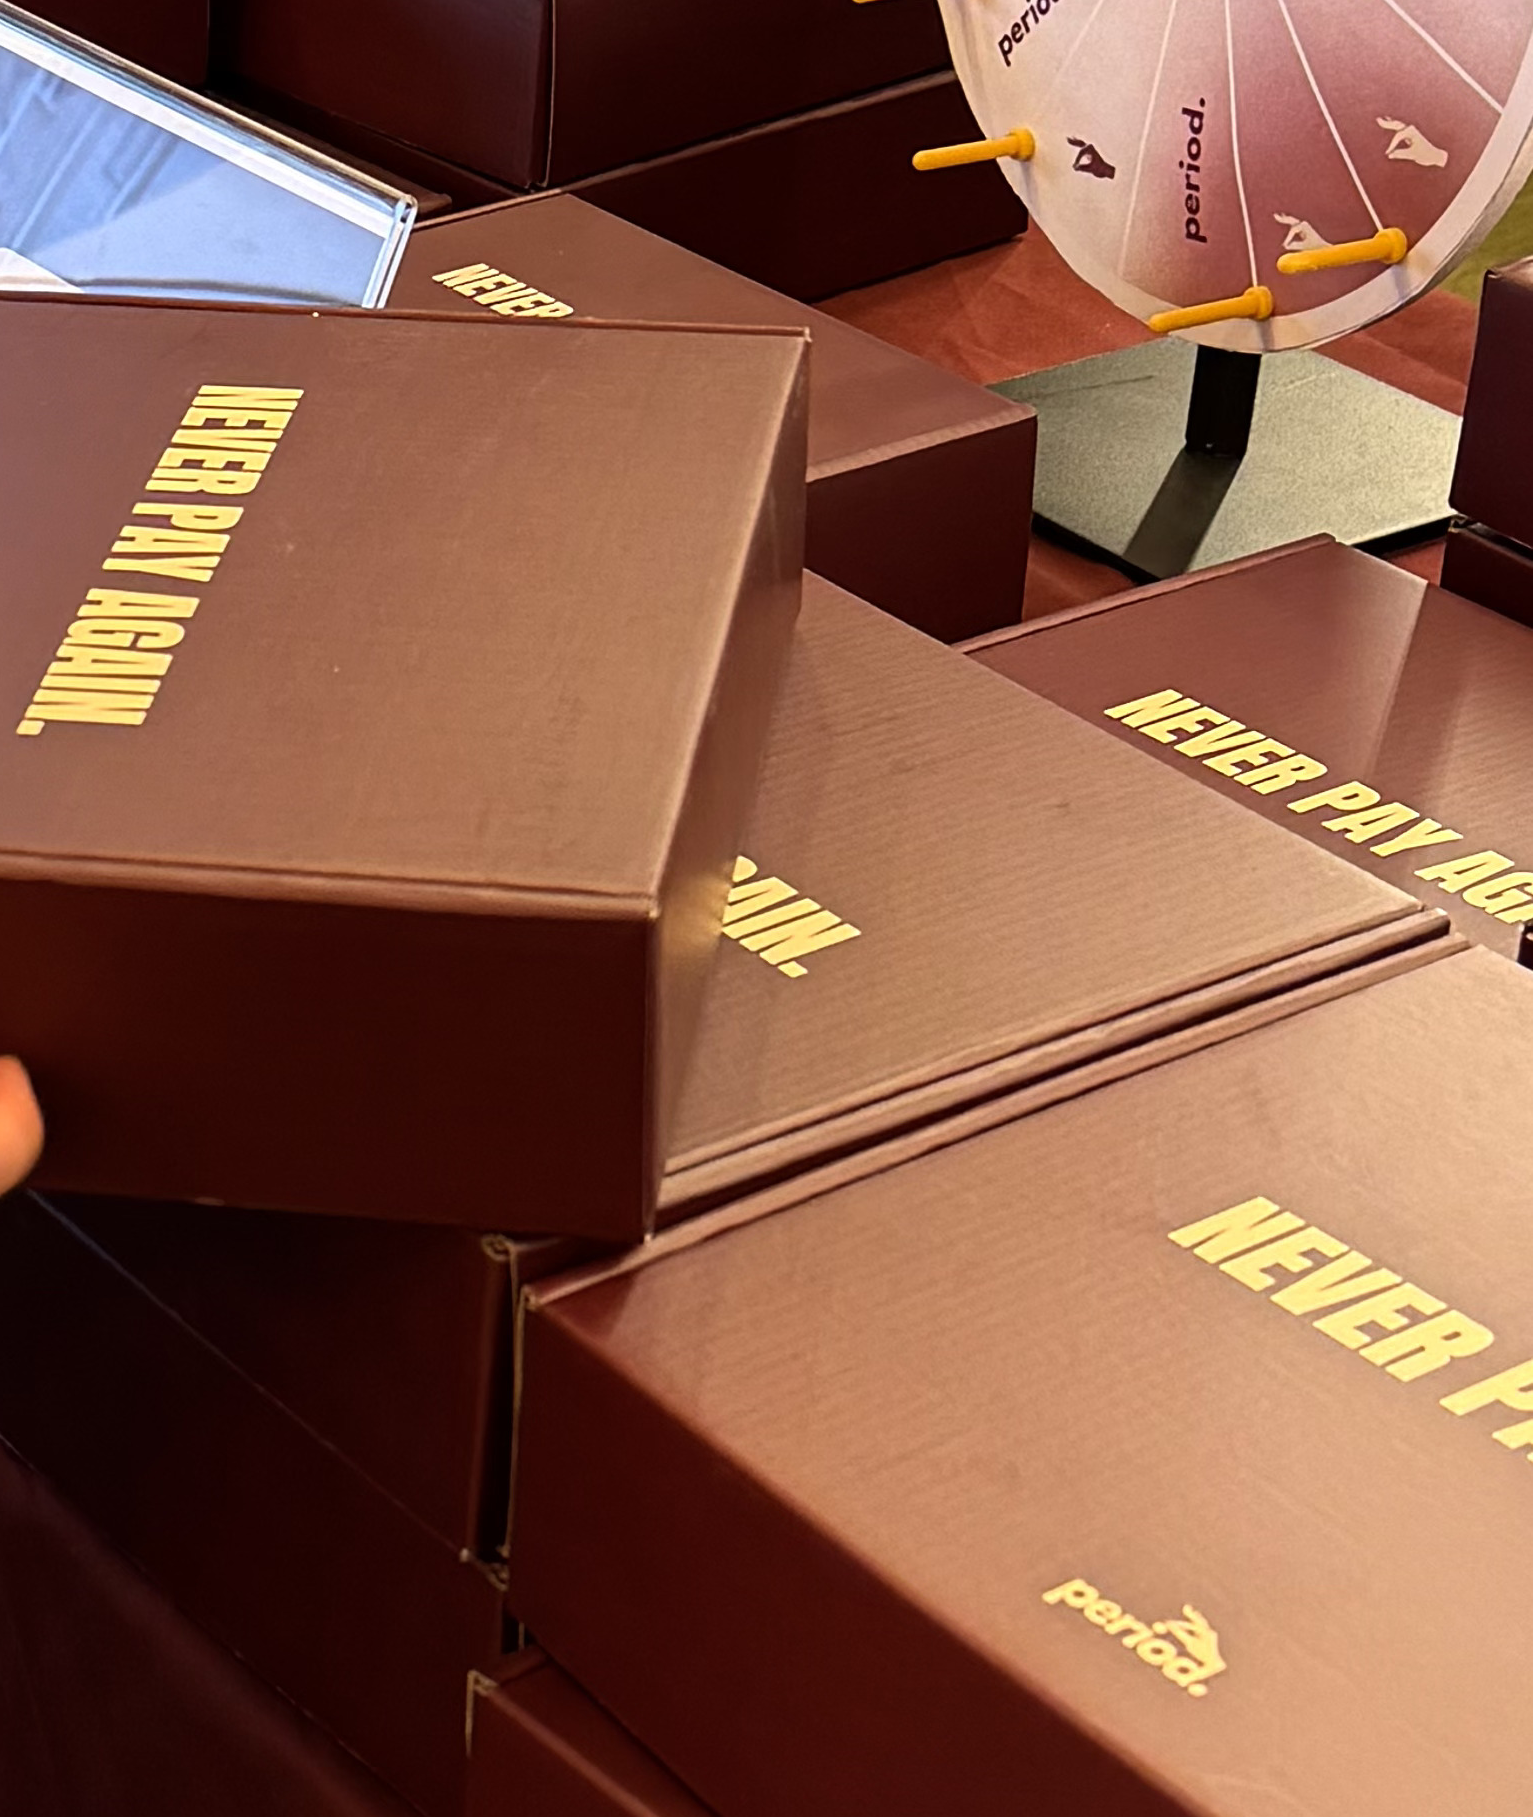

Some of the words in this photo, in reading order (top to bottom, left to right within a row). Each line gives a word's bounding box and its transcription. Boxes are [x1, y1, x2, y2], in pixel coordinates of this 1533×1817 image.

[1178, 97, 1208, 244] period.
[431, 262, 575, 319] NEVER
[145, 384, 306, 496] NEVER
[102, 501, 245, 583] PAY
[15, 587, 201, 736] AGAIN.
[1103, 688, 1329, 796] NEVER
[1287, 780, 1464, 859] PAY
[1167, 1195, 1496, 1383] NEVER
[1042, 1577, 1227, 1698] period.
